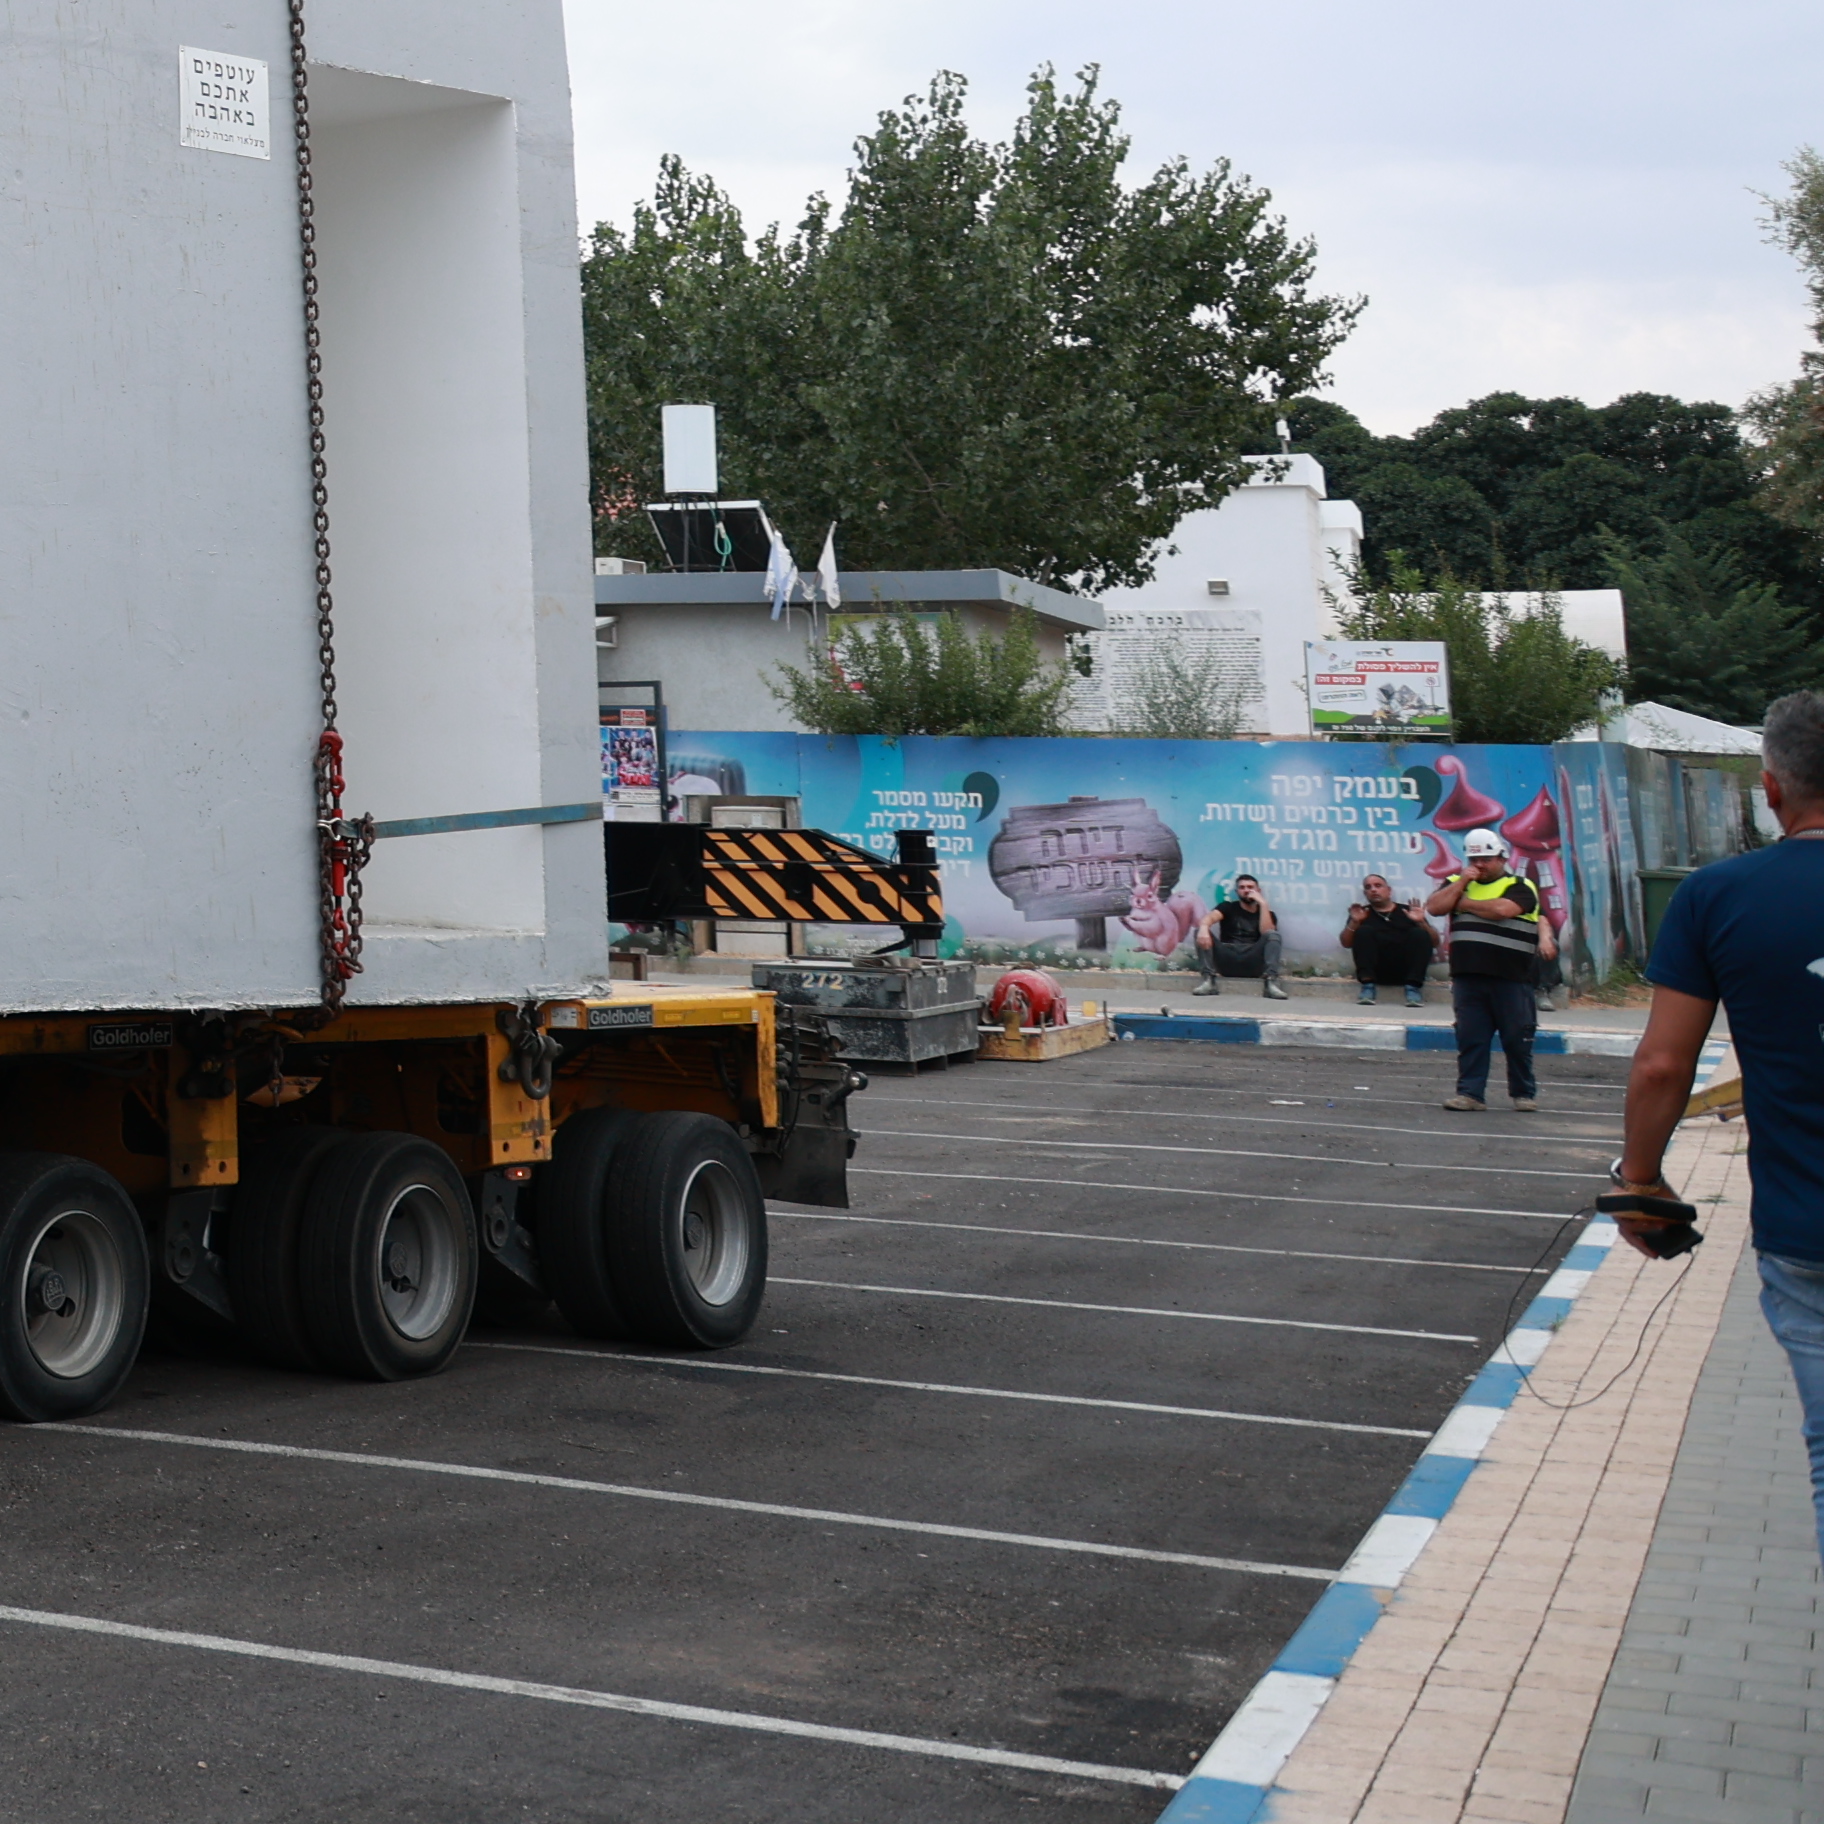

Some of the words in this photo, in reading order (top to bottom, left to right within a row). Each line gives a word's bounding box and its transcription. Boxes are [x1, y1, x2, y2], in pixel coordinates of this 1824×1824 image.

[193, 58, 255, 85] עוטפים
[200, 81, 250, 103] אתכם
[195, 102, 255, 126] באהבה
[1388, 662, 1421, 672] להשליך
[1424, 663, 1438, 672] אין
[1333, 675, 1362, 685] במקום
[1270, 773, 1322, 797] יפה
[1333, 775, 1420, 803] בעמק
[872, 790, 928, 806] מסמר
[933, 792, 984, 810] תקעו
[865, 810, 920, 829] לדלת,
[925, 811, 966, 830] מעל
[1199, 803, 1276, 823] ושדות,
[1284, 804, 1358, 824] כרמים
[1364, 806, 1401, 829] בין
[1040, 825, 1125, 859] דירה
[1263, 823, 1338, 851] מגדל
[1347, 830, 1424, 854] עומד
[1235, 856, 1305, 880] קומות
[1313, 860, 1370, 879] חמש
[802, 972, 843, 991] 272
[590, 1008, 652, 1026] Goldhofer
[92, 1027, 170, 1046] Goldhofer
